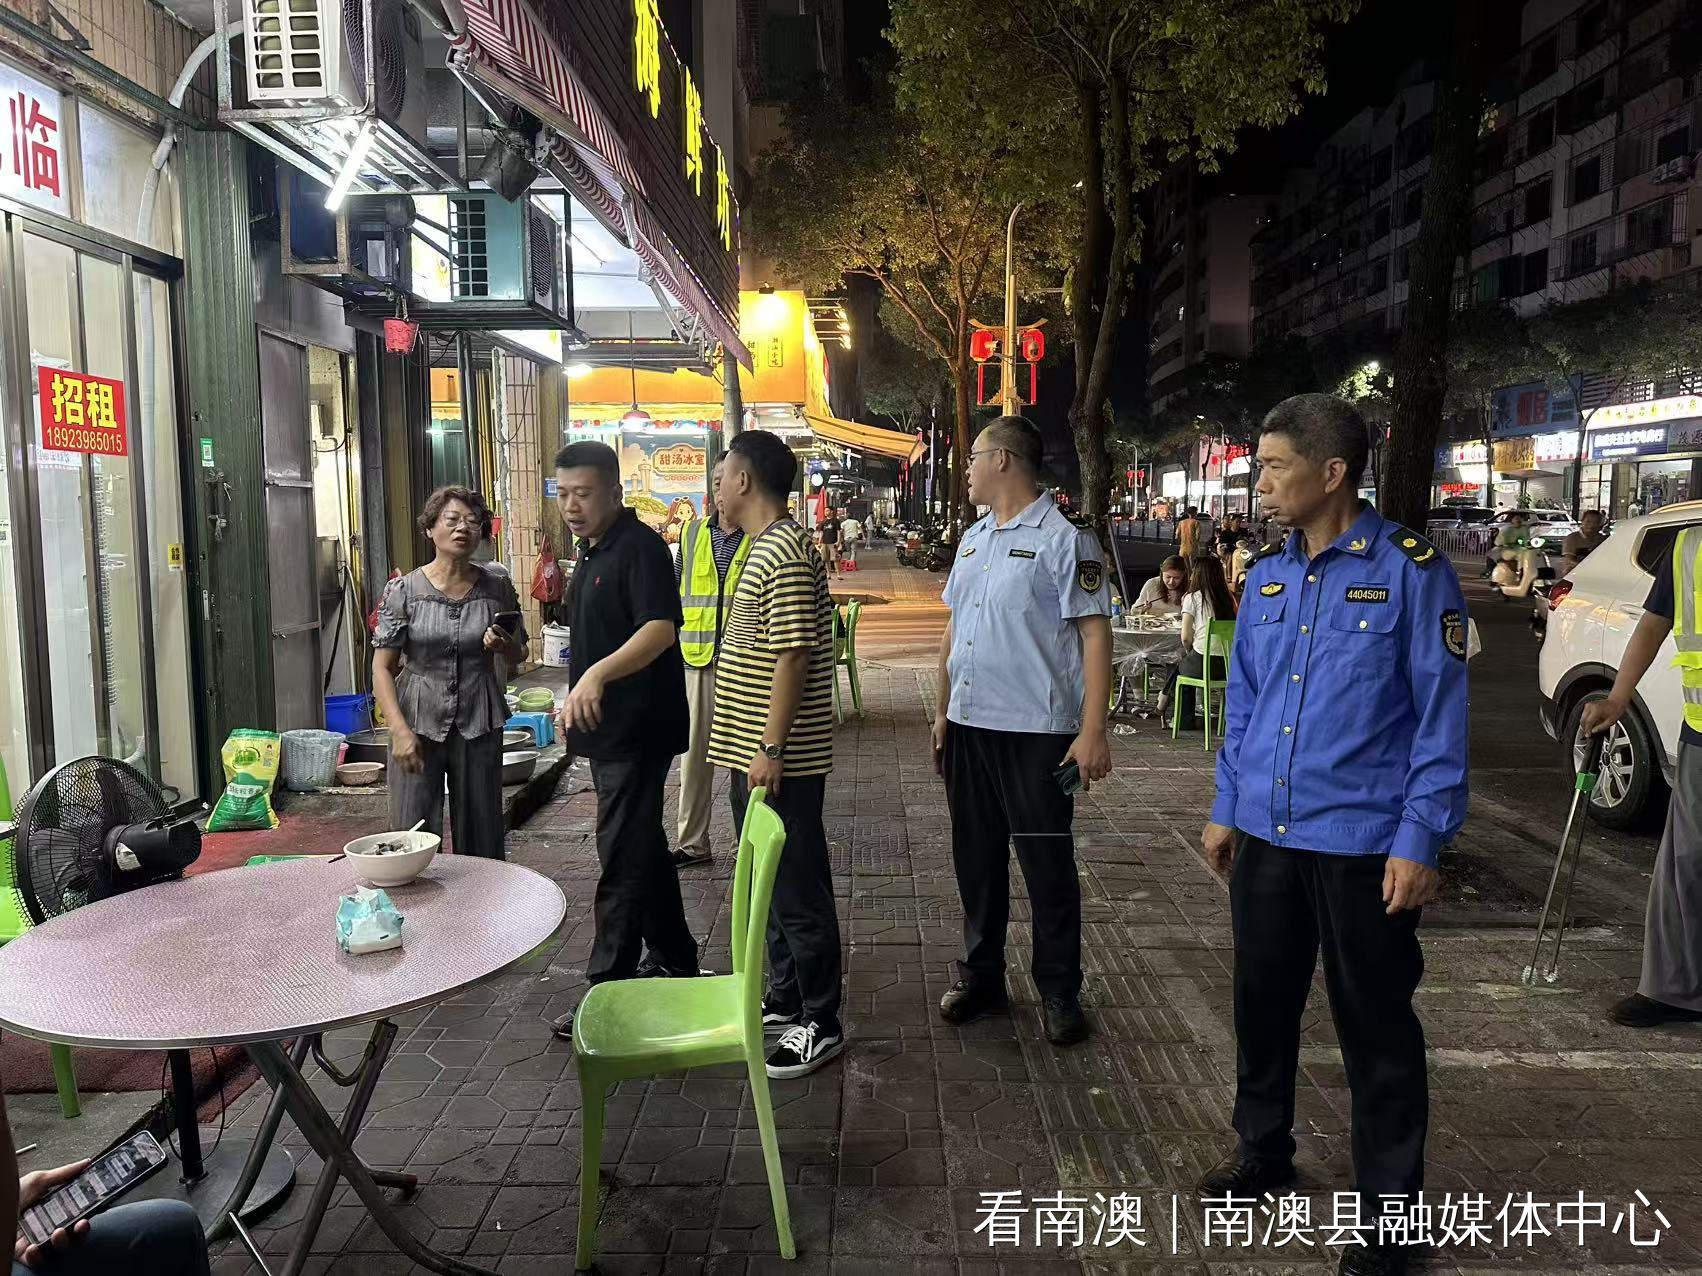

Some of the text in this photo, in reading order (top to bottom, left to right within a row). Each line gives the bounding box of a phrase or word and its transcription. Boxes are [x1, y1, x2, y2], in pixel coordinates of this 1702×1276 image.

[0, 91, 60, 198] 临
[51, 373, 118, 428] 招租
[46, 426, 123, 453] 18923985015
[659, 453, 705, 466] 甜汤冰室
[1347, 589, 1386, 600] 44045011
